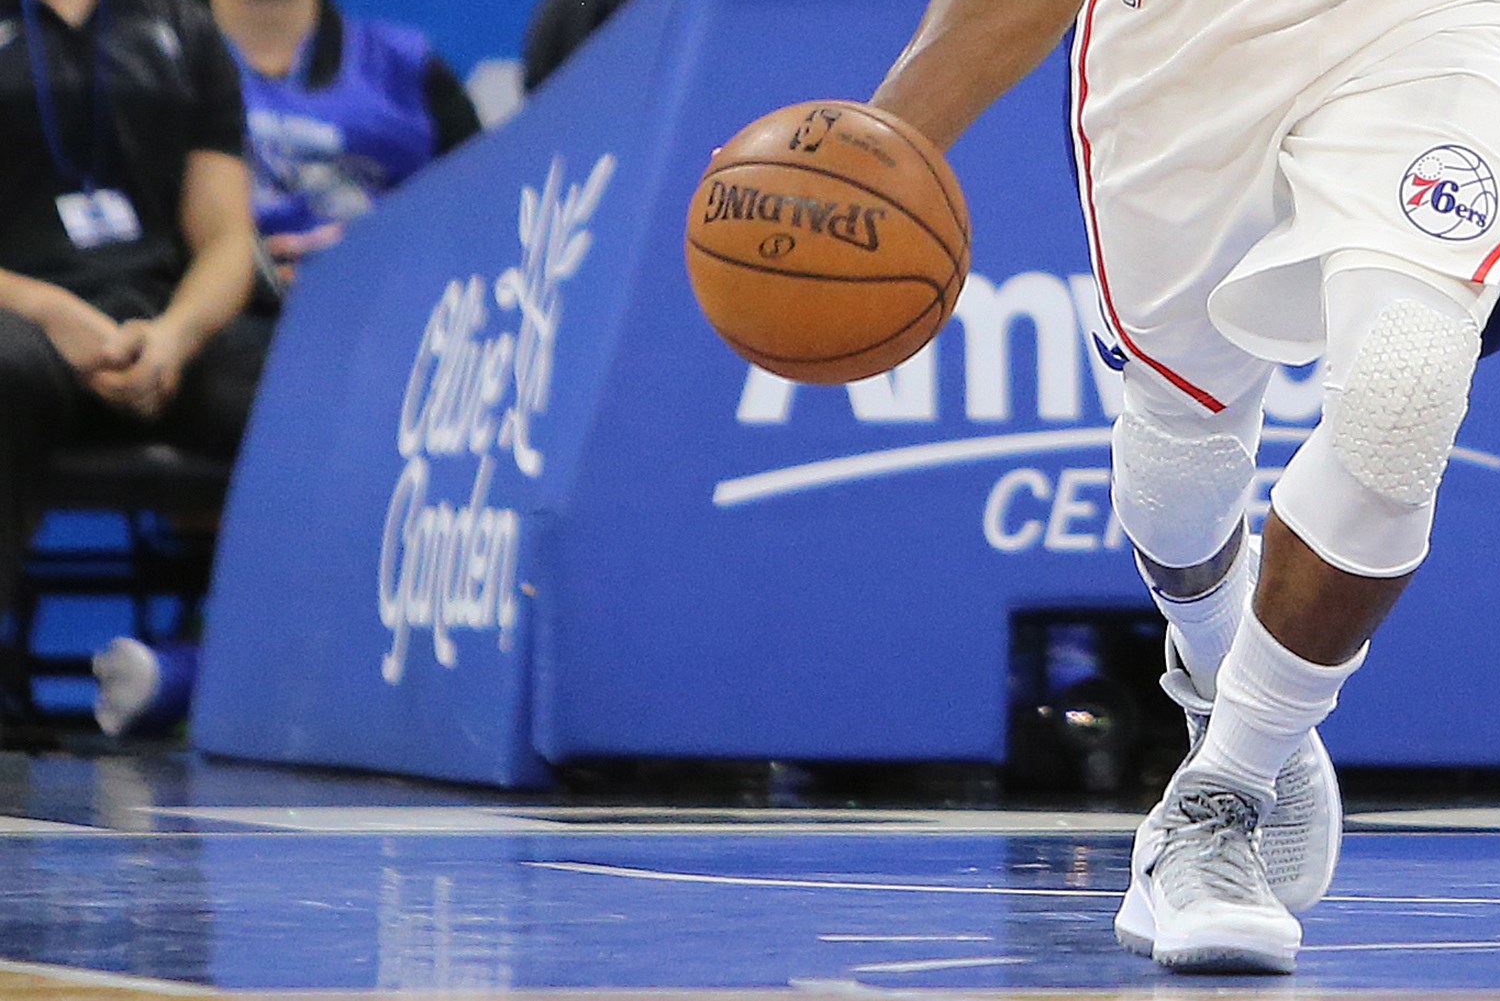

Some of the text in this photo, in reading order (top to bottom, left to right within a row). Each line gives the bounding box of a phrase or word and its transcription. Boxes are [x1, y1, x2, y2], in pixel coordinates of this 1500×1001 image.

[703, 180, 886, 253] SPALDING
[1405, 172, 1488, 228] 76ers
[397, 272, 516, 458] Olive
[378, 454, 521, 686] Garden
